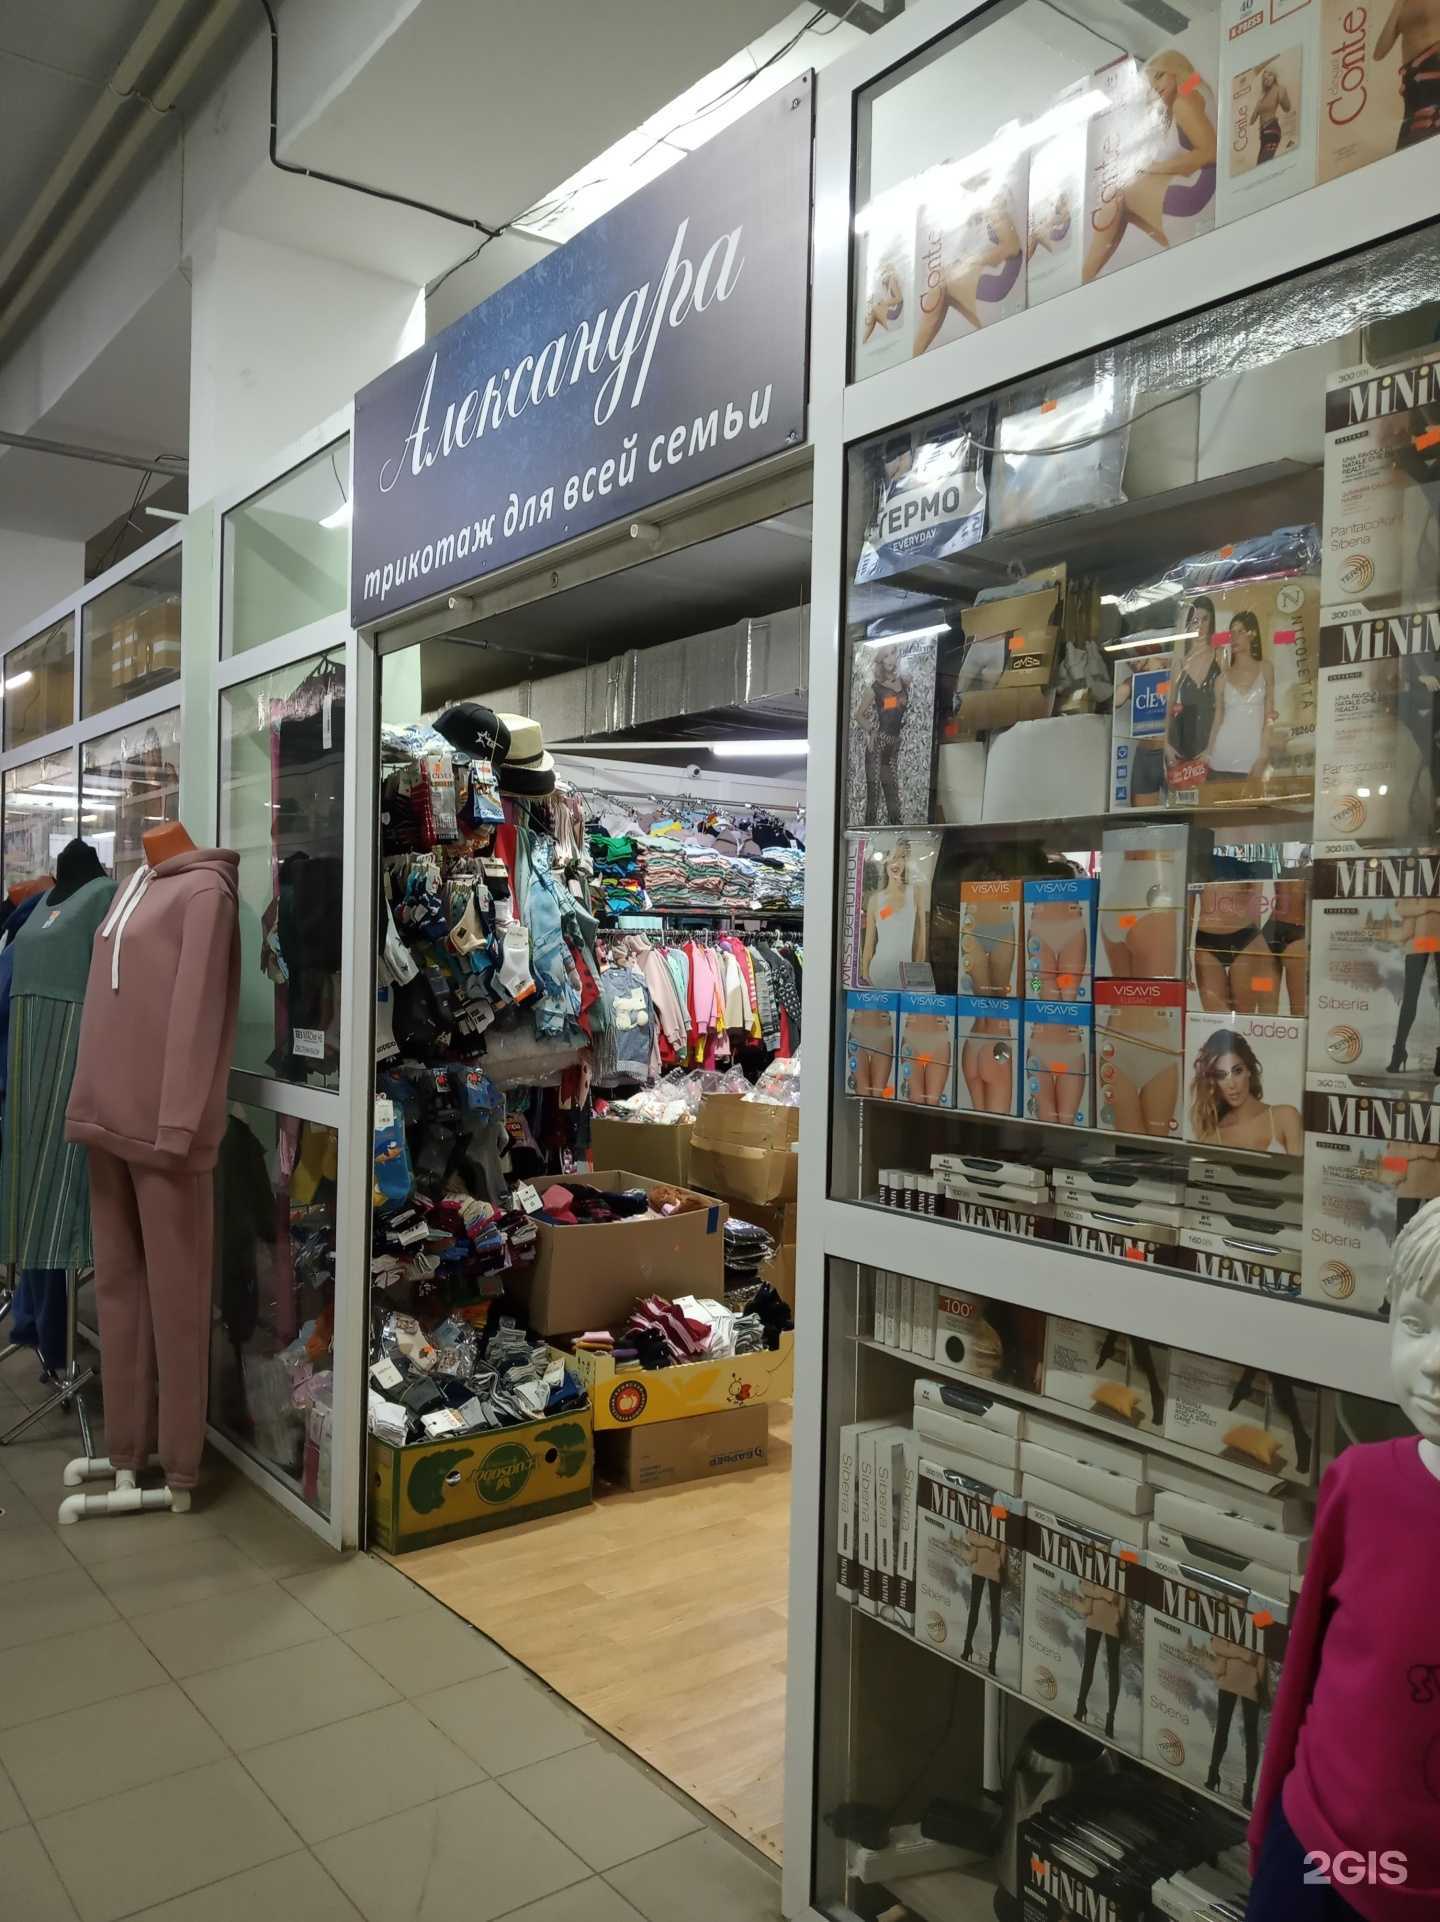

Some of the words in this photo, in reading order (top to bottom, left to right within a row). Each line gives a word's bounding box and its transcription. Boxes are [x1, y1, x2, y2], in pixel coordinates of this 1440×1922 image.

[1327, 7, 1367, 126] Conte
[1233, 105, 1249, 152] Conte
[379, 217, 745, 492] Александра
[364, 511, 496, 601] трикотаж
[503, 490, 553, 538] для
[564, 438, 638, 512] всей
[648, 384, 774, 473] семьи
[894, 528, 936, 553] EVERYDAY
[1292, 616, 1313, 710] NICOLETTA
[844, 846, 858, 940] BEAUTIFUL
[971, 882, 1010, 894] VISAVIS
[1036, 882, 1078, 894] VISAVIS
[1202, 891, 1290, 914] Jadea
[856, 992, 889, 1003] VISAVIS
[909, 995, 946, 1007] VISAVIS
[1113, 984, 1161, 997] VISAVIS
[971, 998, 1010, 1010] VISAVIS
[1037, 1004, 1079, 1016] VISAVIS
[1318, 995, 1369, 1011] Siberia
[1243, 1019, 1299, 1040] Jadea
[1311, 1228, 1361, 1249] Siberia
